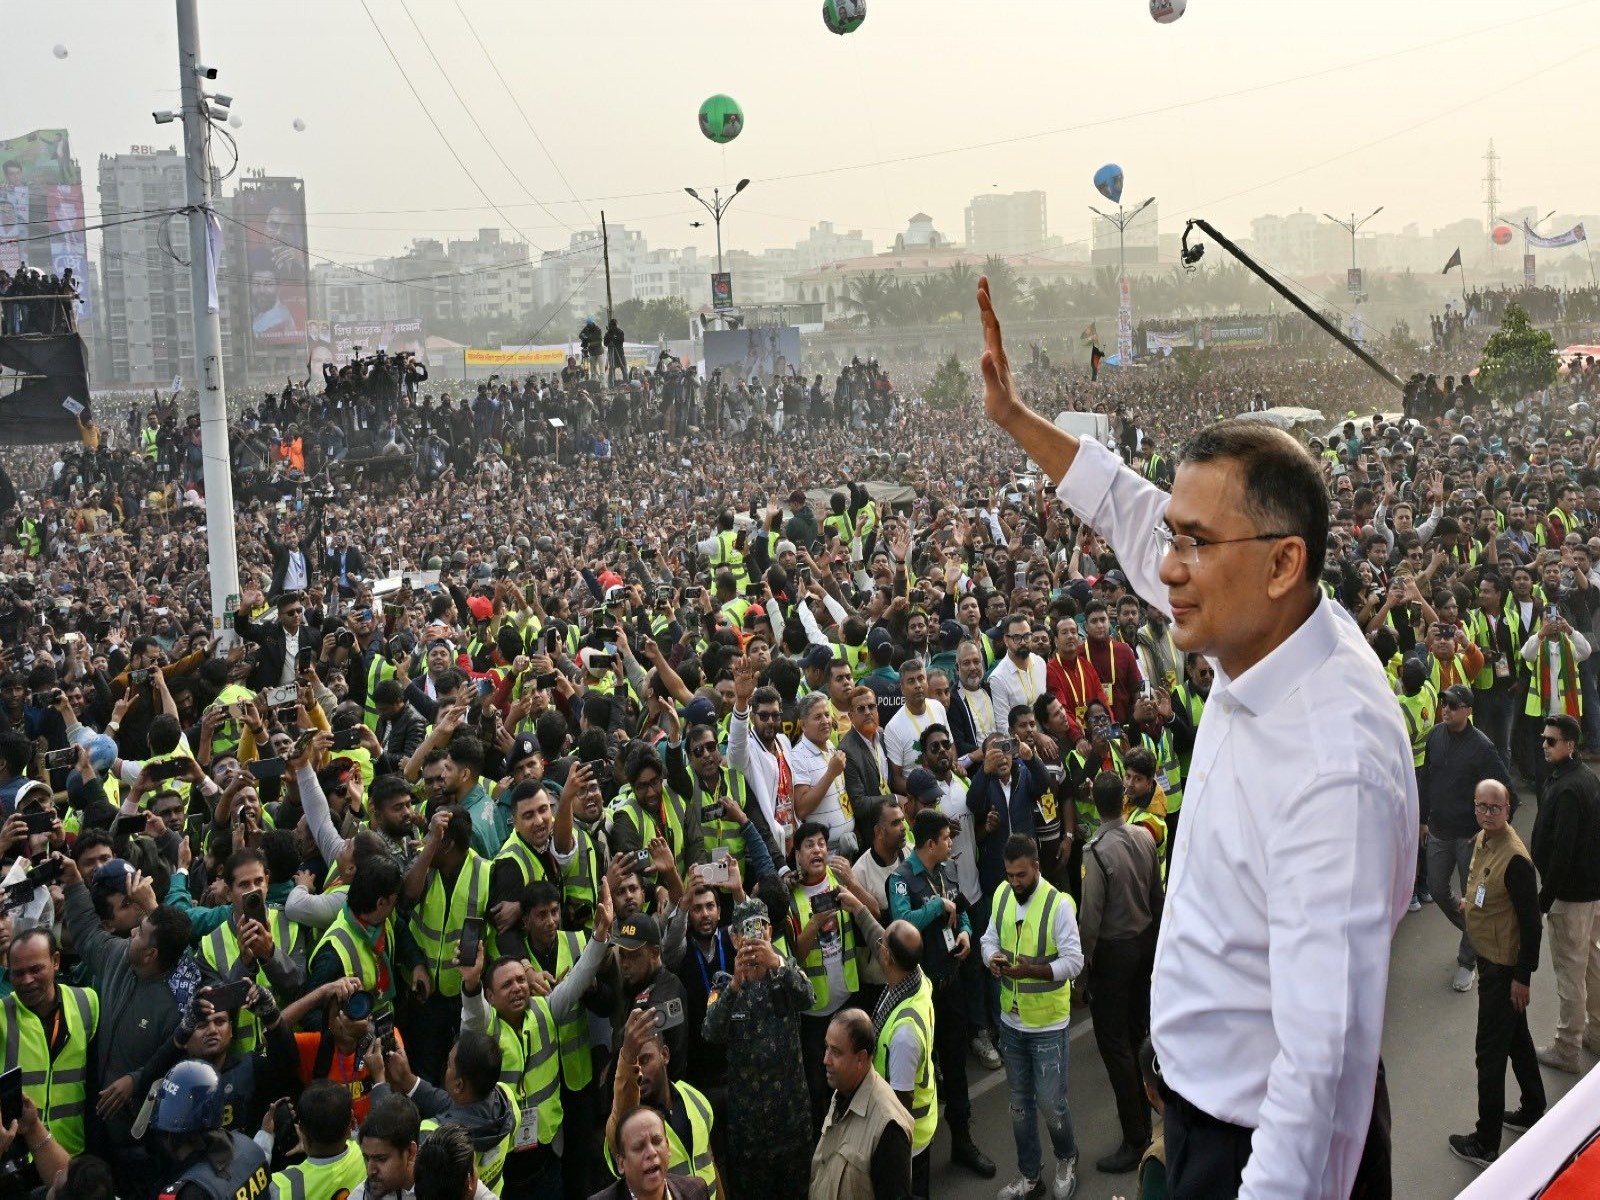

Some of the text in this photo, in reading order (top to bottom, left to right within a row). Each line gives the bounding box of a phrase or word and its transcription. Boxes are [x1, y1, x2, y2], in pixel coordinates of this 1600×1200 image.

[130, 144, 156, 155] RBL
[877, 696, 906, 706] POLICE
[236, 1167, 268, 1200] RAB
